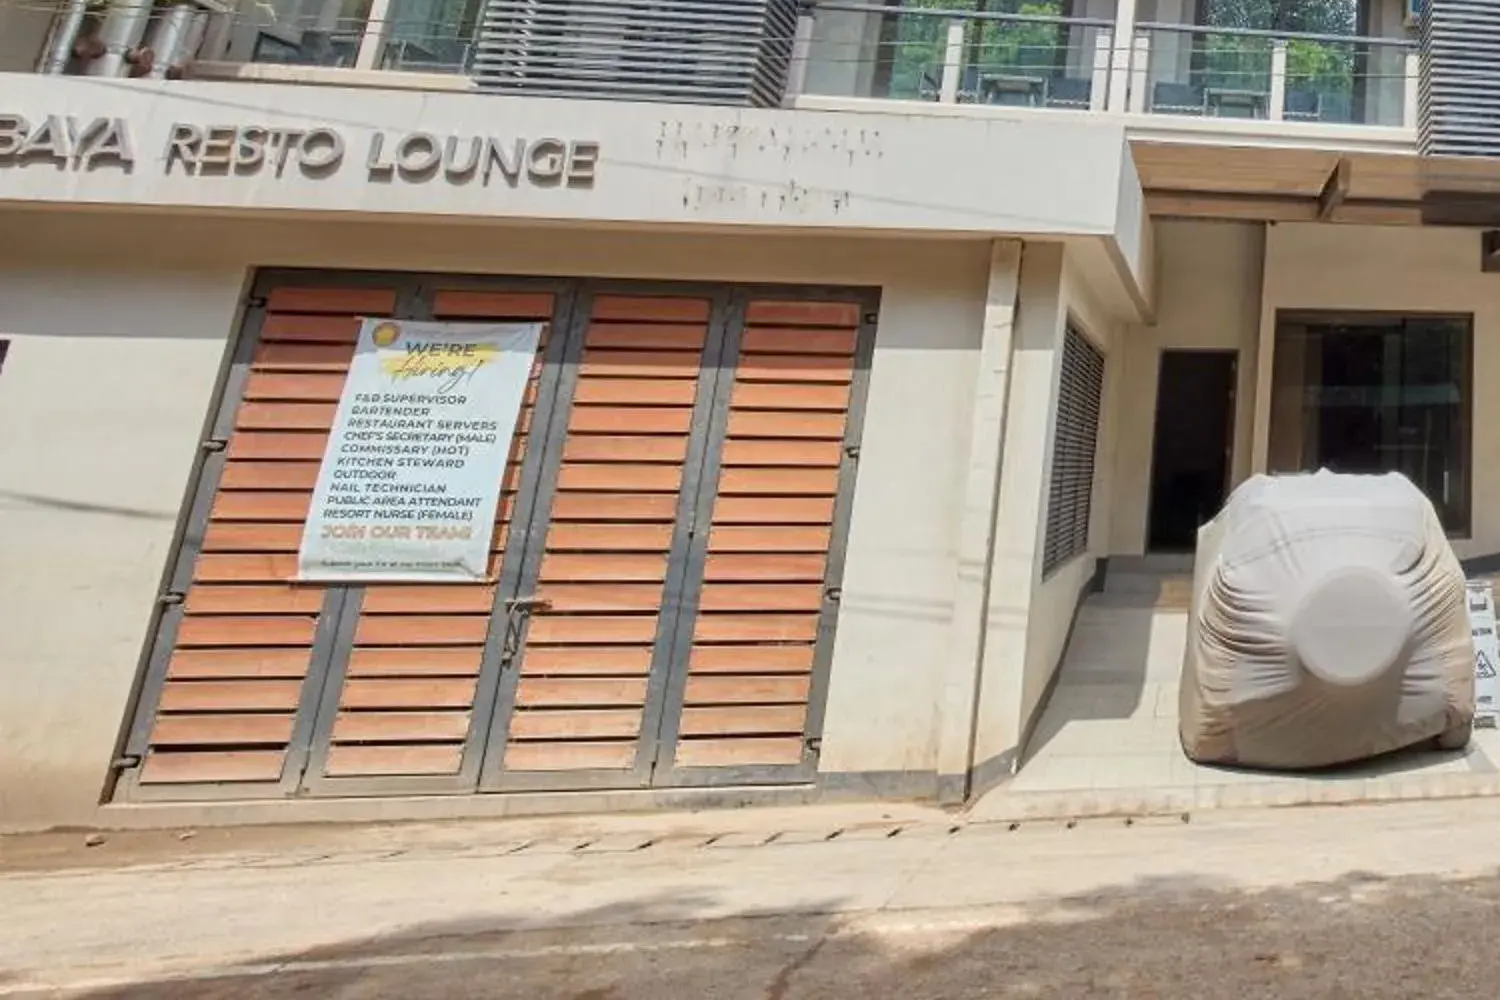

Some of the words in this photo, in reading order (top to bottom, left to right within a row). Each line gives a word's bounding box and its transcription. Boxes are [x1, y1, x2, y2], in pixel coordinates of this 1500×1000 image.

[164, 124, 346, 180] RESTO
[366, 131, 601, 190] LOUNGE
[383, 393, 467, 405] SUPERVISOR
[351, 407, 431, 417] BARTENDER
[347, 419, 434, 430] RESTAURANT
[437, 421, 497, 431] SERVERS
[385, 431, 454, 443] SECRETARY
[455, 433, 497, 444] (MALE)
[341, 444, 429, 455] COMMISSARY
[337, 457, 394, 468] KITCHEN
[397, 458, 465, 469] STEWARD
[333, 470, 397, 480] OUTDOOR
[330, 483, 361, 493] NAIL
[365, 483, 447, 494] TECHNICIAN
[327, 496, 369, 506] PUBLIC
[373, 496, 405, 507] AREA
[408, 497, 483, 508] ATTENDANT
[323, 509, 371, 519] RESORT
[373, 509, 415, 520] NURSE
[417, 510, 474, 522] (FEMALE)
[321, 525, 366, 538] JOIN
[371, 526, 411, 539] OUR
